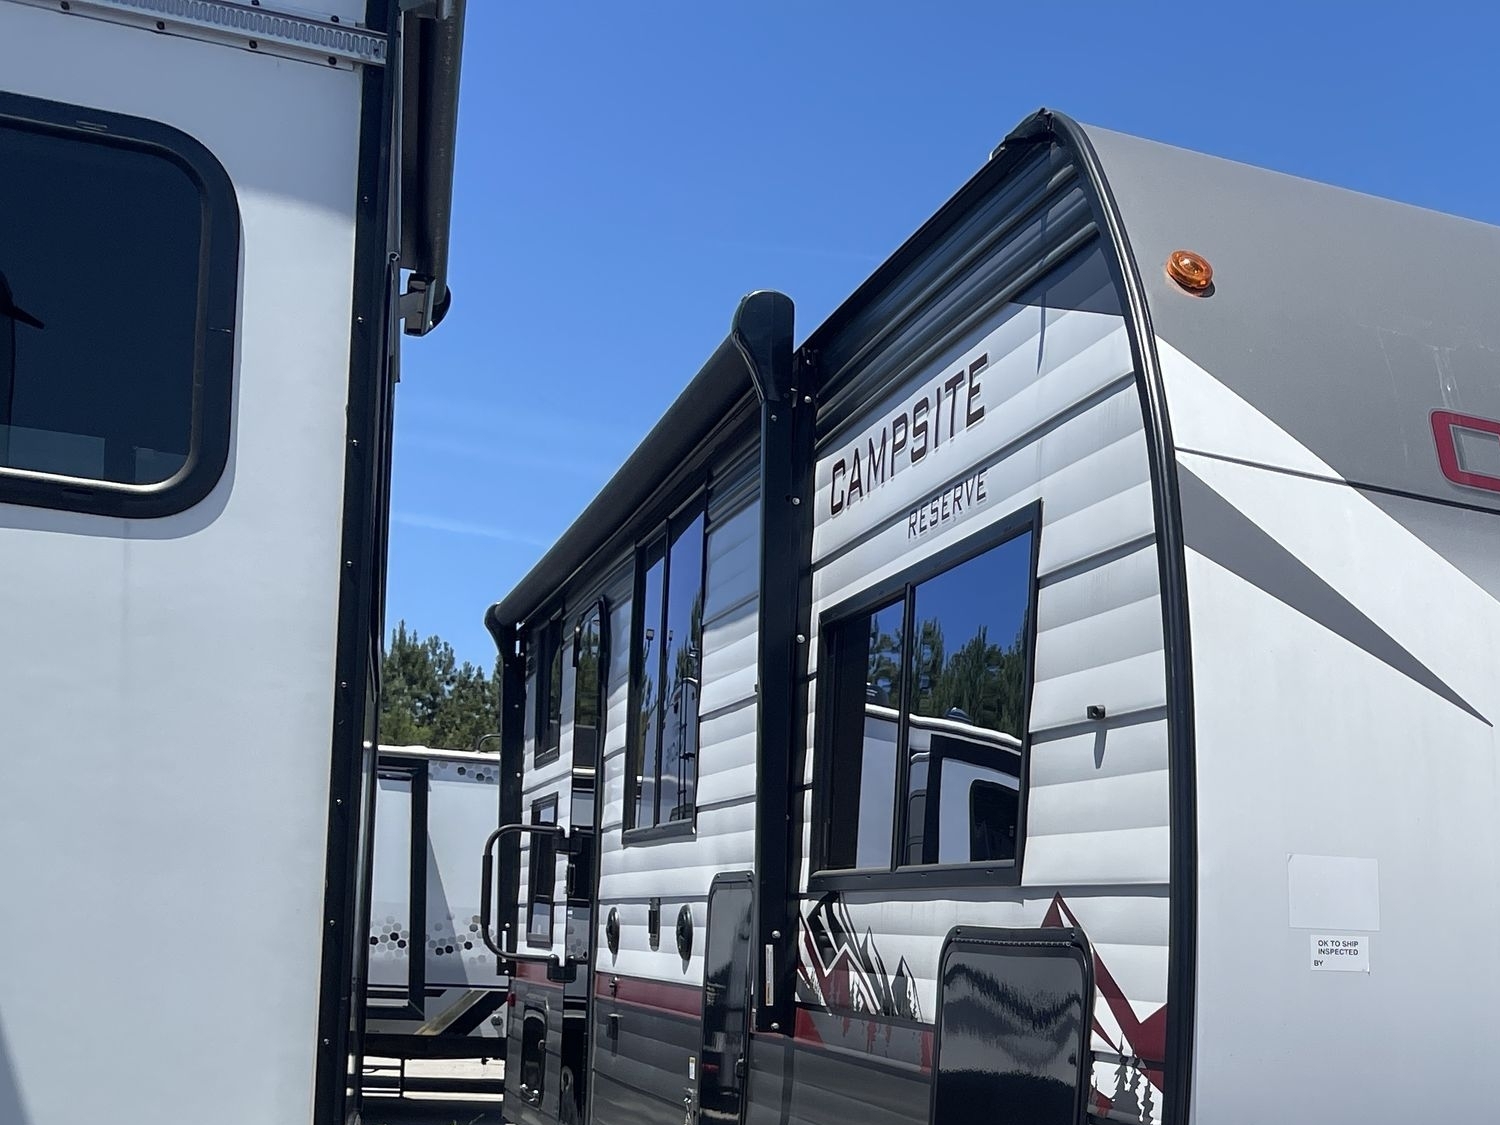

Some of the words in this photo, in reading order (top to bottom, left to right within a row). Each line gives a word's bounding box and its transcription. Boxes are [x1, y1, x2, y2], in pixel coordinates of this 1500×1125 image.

[830, 353, 988, 516] CAMPSITE
[908, 467, 988, 540] RESERVE
[1317, 940, 1329, 948] OK
[1330, 940, 1341, 948] TO
[1341, 940, 1359, 948] SHIP
[1317, 948, 1359, 956] INSPECTED
[1313, 959, 1324, 967] BY
